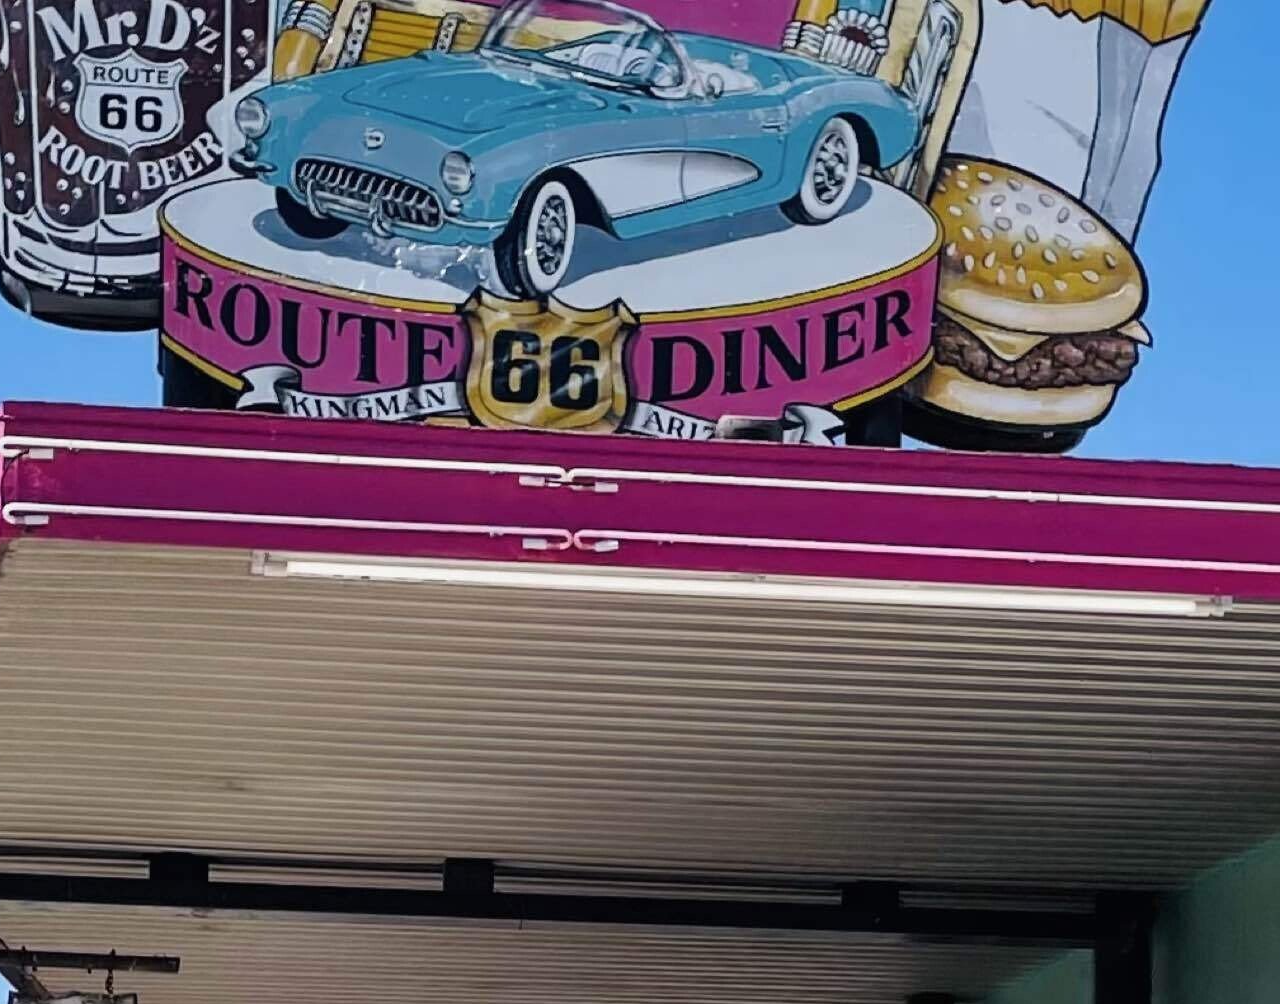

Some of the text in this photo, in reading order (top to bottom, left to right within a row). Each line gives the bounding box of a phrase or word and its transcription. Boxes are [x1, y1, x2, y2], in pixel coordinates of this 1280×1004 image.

[93, 66, 169, 85] ROUTE
[99, 93, 163, 133] 66
[38, 126, 223, 190] ROOT BEER
[174, 257, 912, 410] ROUTE 66 DINER
[290, 386, 447, 419] KINGMAN
